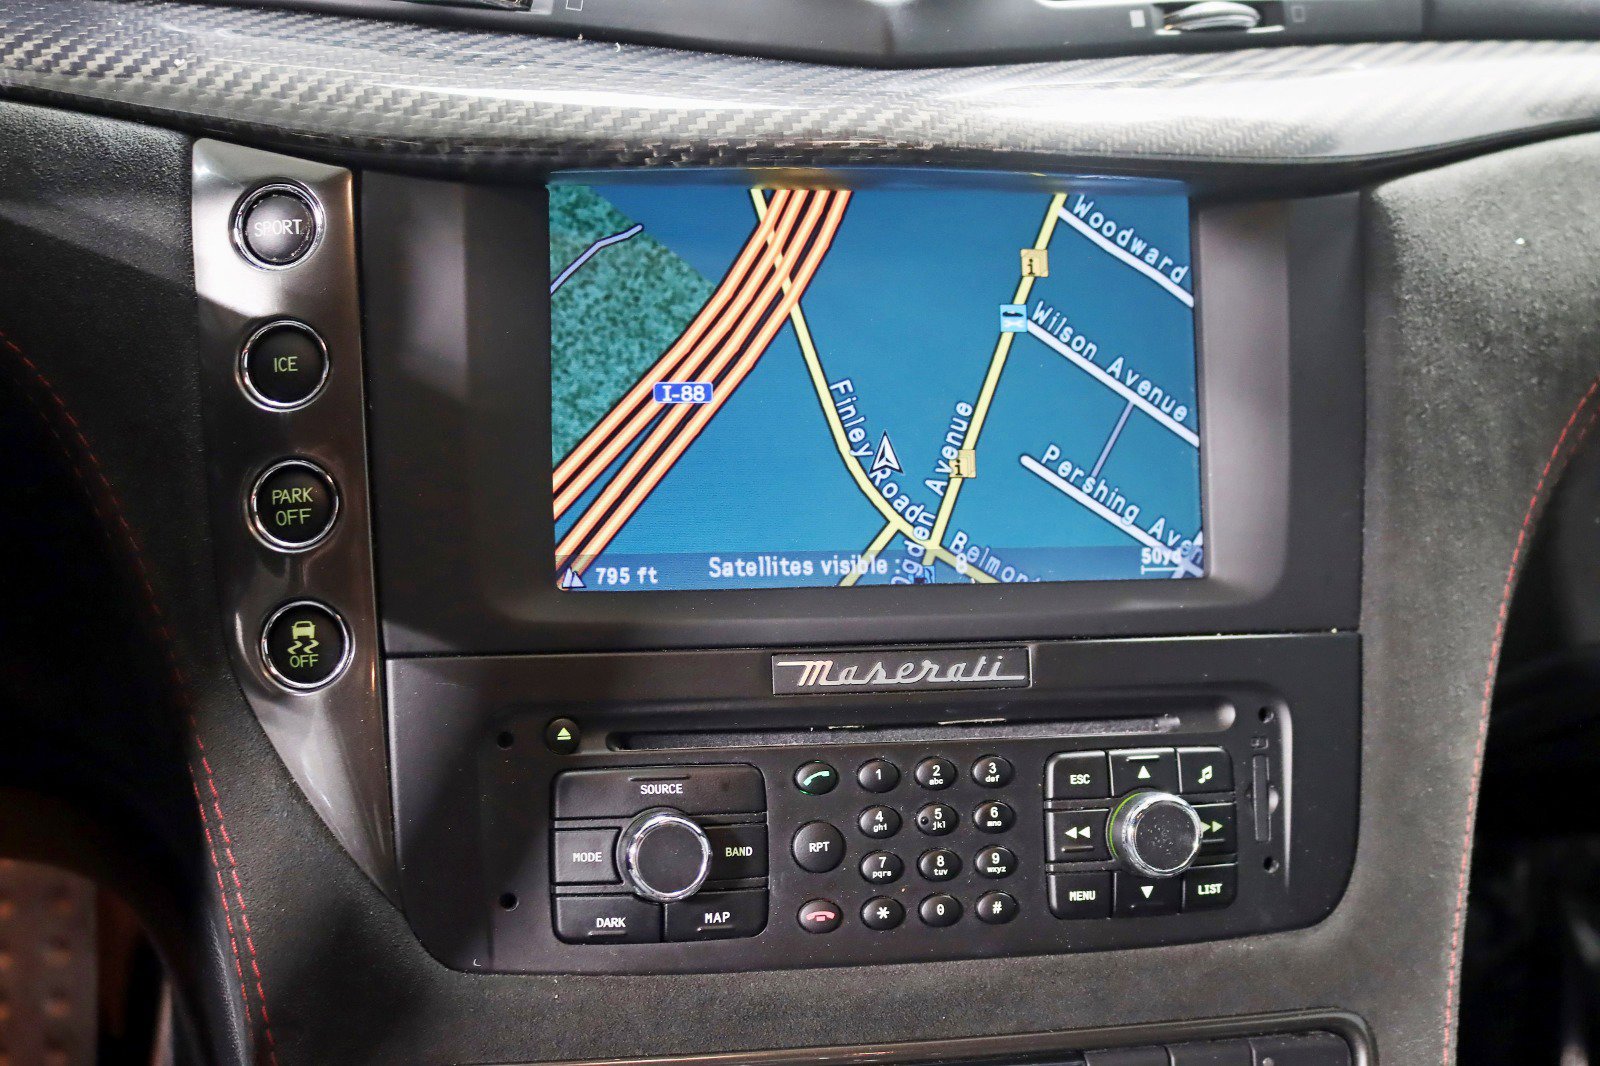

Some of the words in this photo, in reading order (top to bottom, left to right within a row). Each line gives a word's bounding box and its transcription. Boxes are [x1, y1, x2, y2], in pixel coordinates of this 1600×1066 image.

[254, 218, 302, 237] SPORT
[1073, 194, 1189, 284] Woodward
[273, 356, 298, 372] ICE
[1032, 301, 1098, 360] Wilson
[1106, 357, 1188, 422] Avenue
[662, 385, 705, 402] I-88
[829, 379, 873, 457] Finley
[869, 467, 925, 523] Road
[925, 401, 973, 496] Avenue
[1041, 444, 1140, 525] Pershing
[271, 487, 313, 505] PARK
[276, 508, 312, 526] OFF
[708, 556, 814, 578] Satellites
[821, 554, 888, 575] visible
[595, 567, 630, 584] 795
[637, 566, 658, 584] ft
[289, 652, 319, 668] OFF
[777, 655, 1026, 686] Maserati
[932, 765, 941, 776] 2
[988, 762, 997, 774] 3
[875, 769, 882, 780] 1
[985, 774, 1000, 783] def
[1070, 774, 1090, 785] ESC
[929, 777, 944, 785] abc
[640, 783, 683, 794] SOURCE
[875, 811, 884, 822] 4
[934, 808, 943, 819] 5
[990, 806, 998, 818] 6
[873, 823, 888, 832] ghi
[932, 820, 946, 830] jkl
[725, 846, 753, 857] BAND
[809, 841, 830, 852] RPT
[572, 852, 602, 863] MODE
[878, 857, 887, 868] 7
[936, 855, 945, 867] 8
[991, 853, 1000, 864] 9
[872, 869, 892, 878] pqrs
[934, 867, 948, 876] tuv
[987, 865, 1006, 874] wxyz
[1197, 883, 1223, 895] LIST
[1069, 890, 1096, 901] MENU
[936, 904, 945, 915] 0
[596, 917, 626, 928] DARK
[704, 911, 731, 923] MAP
